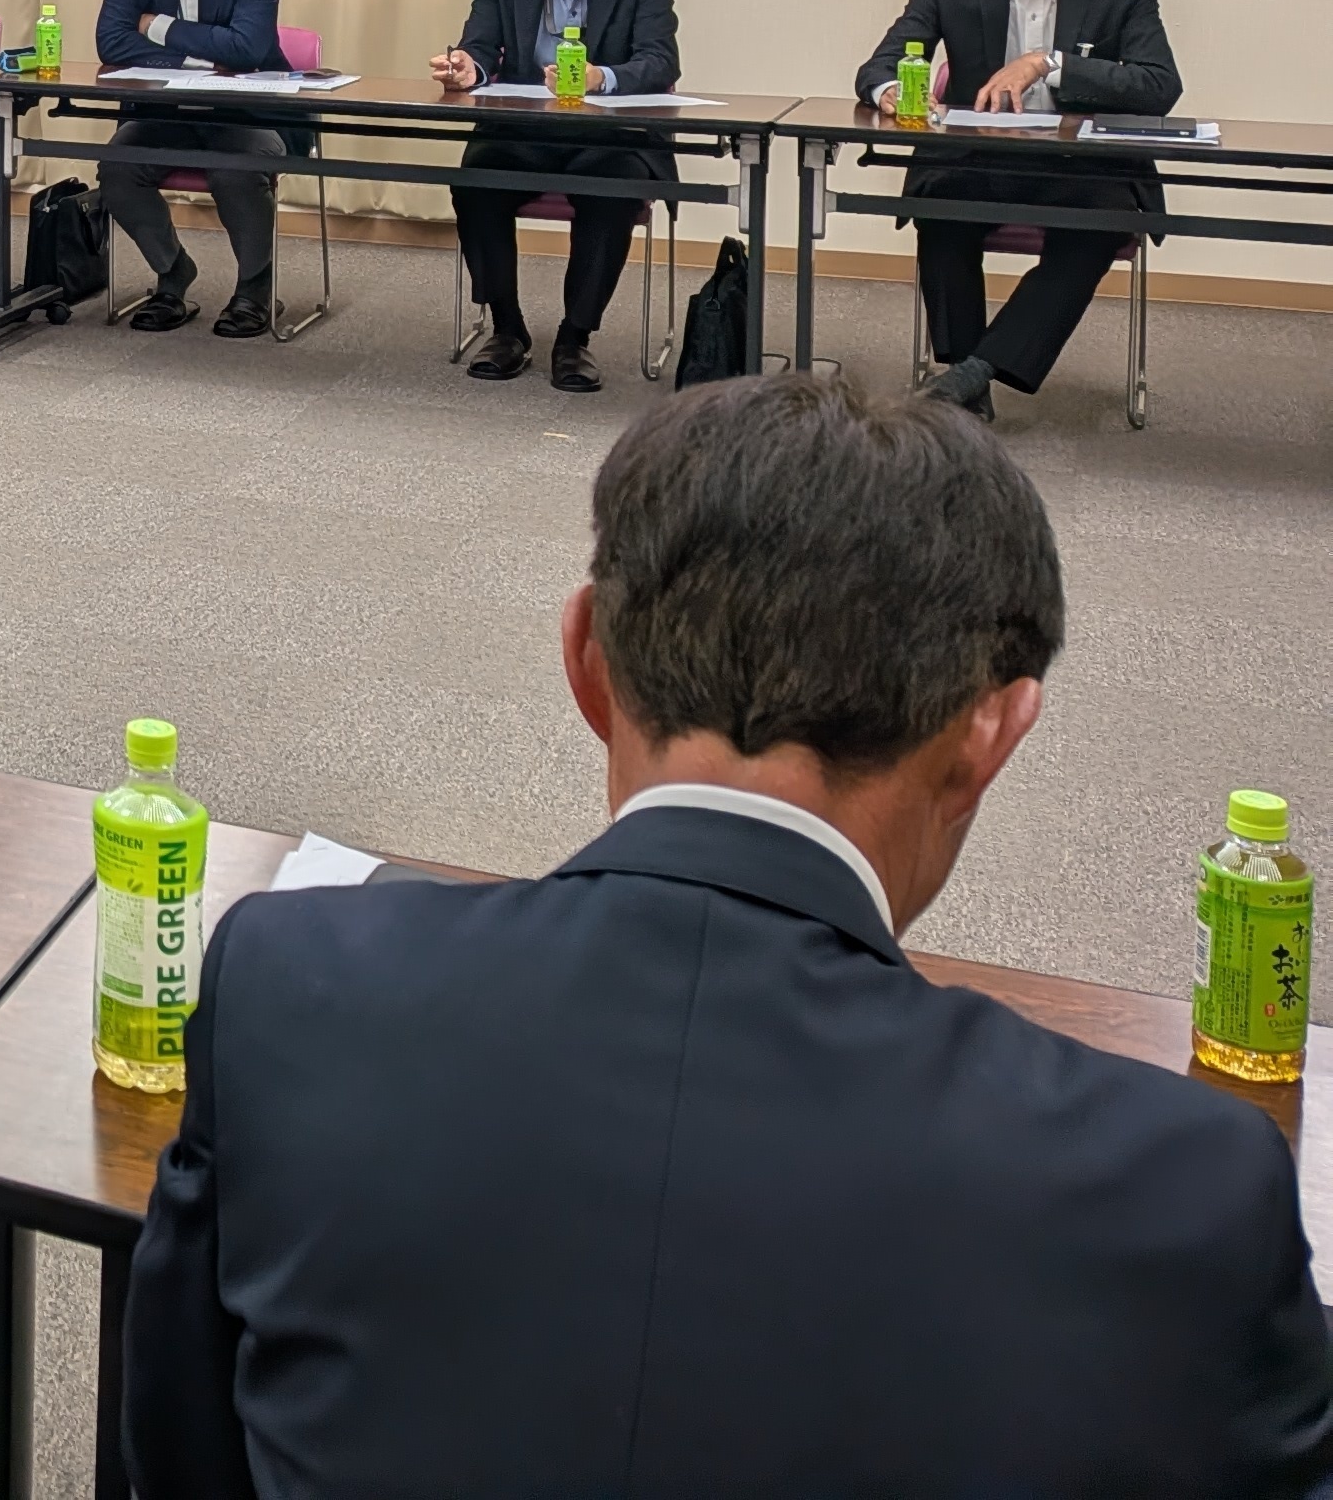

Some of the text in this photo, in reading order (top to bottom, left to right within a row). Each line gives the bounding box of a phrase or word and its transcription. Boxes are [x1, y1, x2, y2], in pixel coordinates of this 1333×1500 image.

[105, 828, 144, 851] GREEN
[157, 840, 187, 1057] PURE GREEN
[1271, 943, 1304, 1011] お茶
